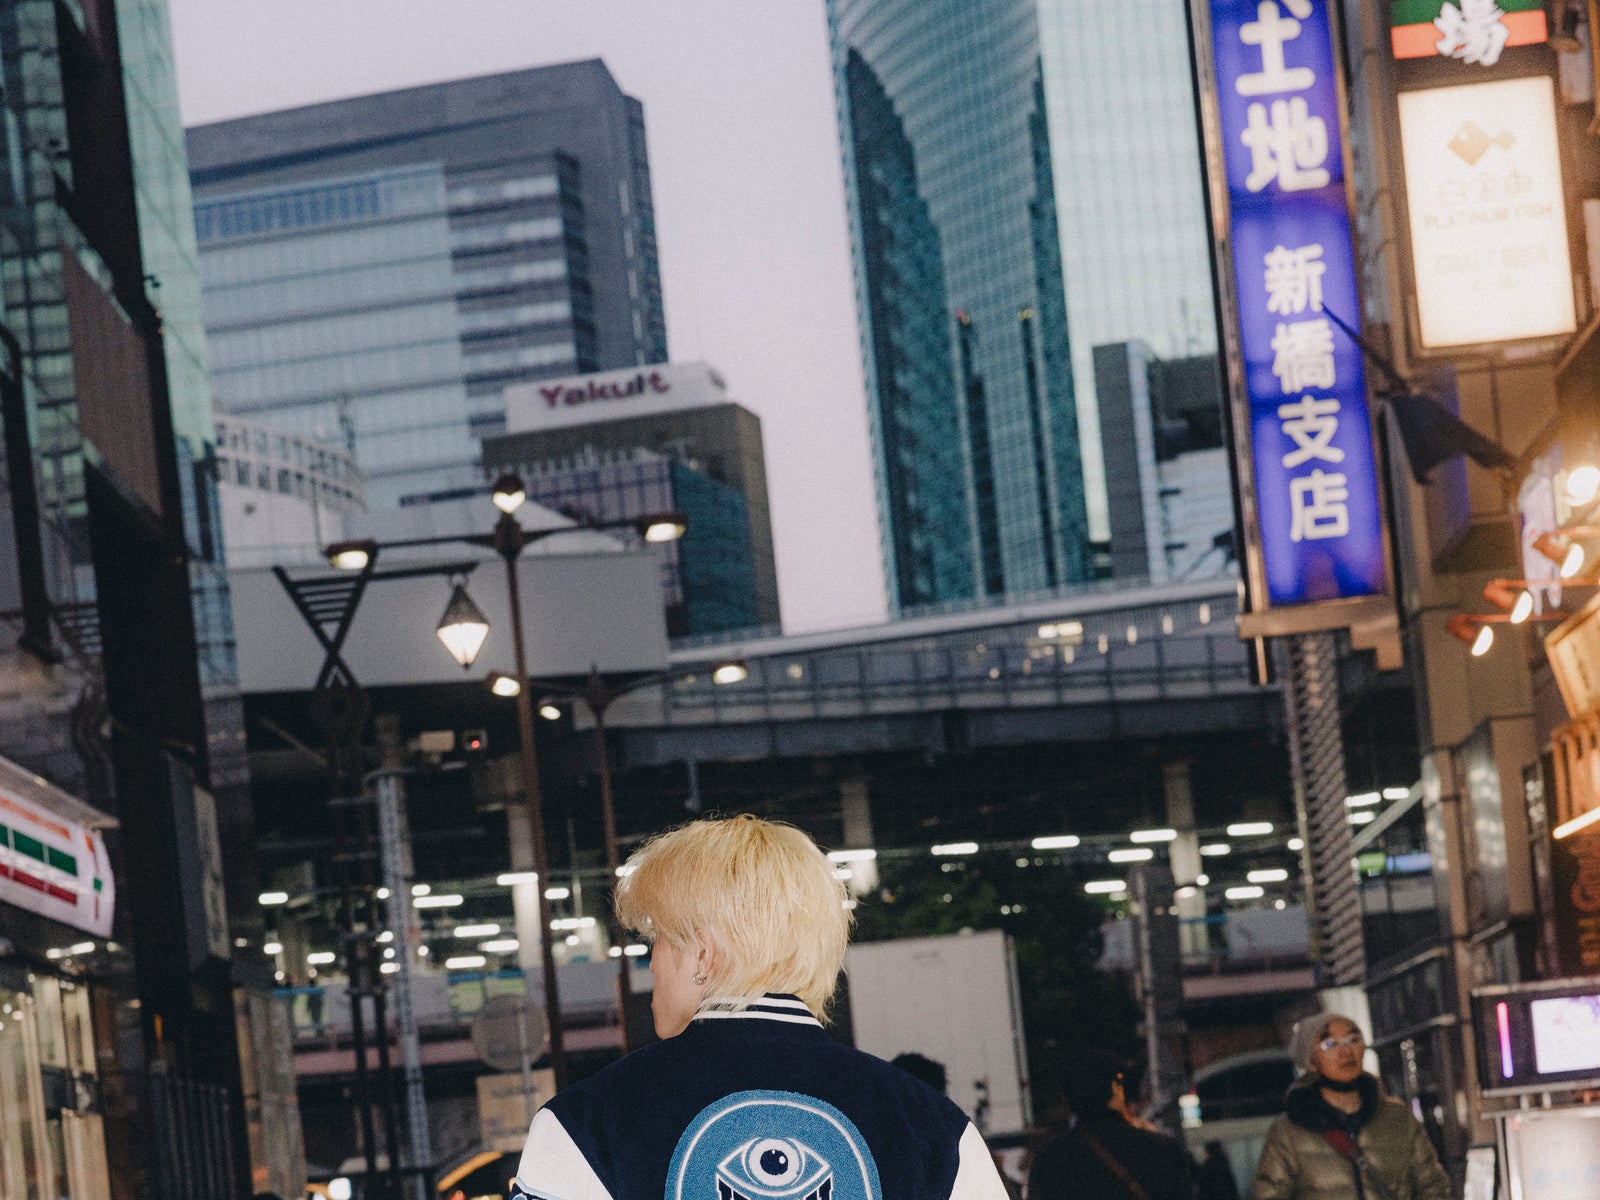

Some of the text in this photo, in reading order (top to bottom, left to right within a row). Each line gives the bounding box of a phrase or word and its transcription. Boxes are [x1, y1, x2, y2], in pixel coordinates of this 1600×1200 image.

[1235, 0, 1331, 193] 土地
[539, 371, 671, 408] Yakult
[1264, 242, 1349, 543] 新橋支店
